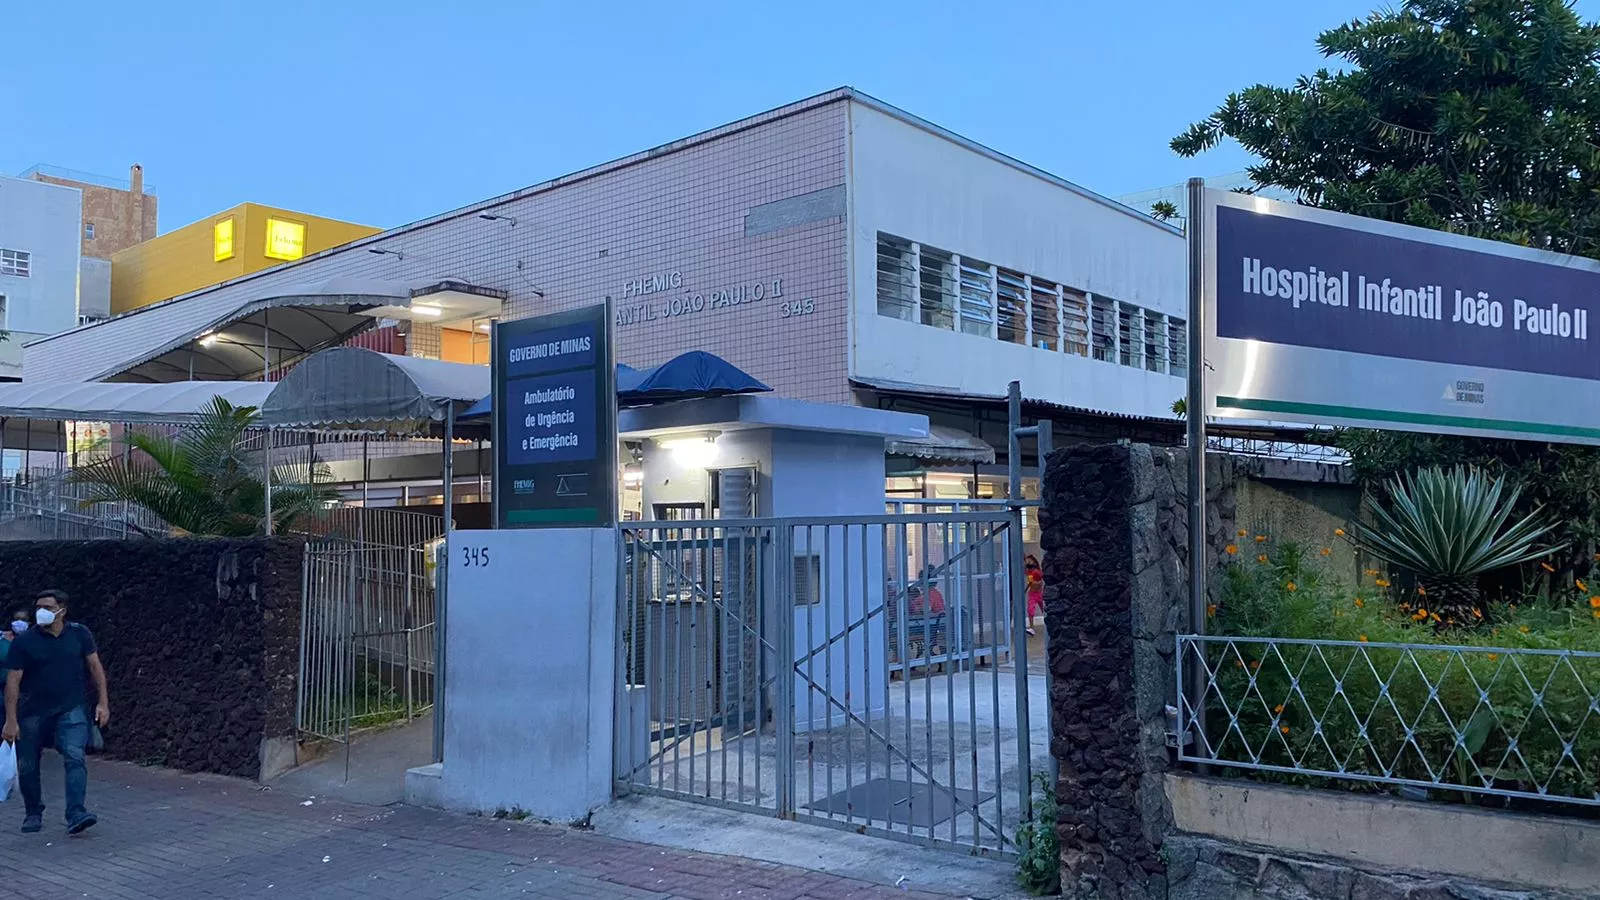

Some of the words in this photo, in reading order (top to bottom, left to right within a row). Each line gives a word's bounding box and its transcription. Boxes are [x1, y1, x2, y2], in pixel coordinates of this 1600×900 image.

[623, 271, 683, 299] FHEMIG
[662, 288, 705, 318] JOÃO
[709, 282, 766, 310] PAULO
[771, 277, 784, 299] II
[781, 298, 815, 318] 345
[1243, 257, 1349, 308] Hospital
[1358, 275, 1442, 320] Infantil
[1452, 290, 1503, 328] João
[1513, 299, 1571, 338] Paulo
[1574, 308, 1588, 340] II
[509, 343, 548, 363] GOVERNO
[548, 341, 561, 357] DE
[560, 336, 591, 354] MINAS
[524, 386, 575, 405] Ambulatório
[525, 413, 536, 427] de
[537, 410, 575, 428] Urgência
[522, 439, 528, 450] e
[529, 432, 578, 451] Emergência
[462, 546, 490, 567] 345
